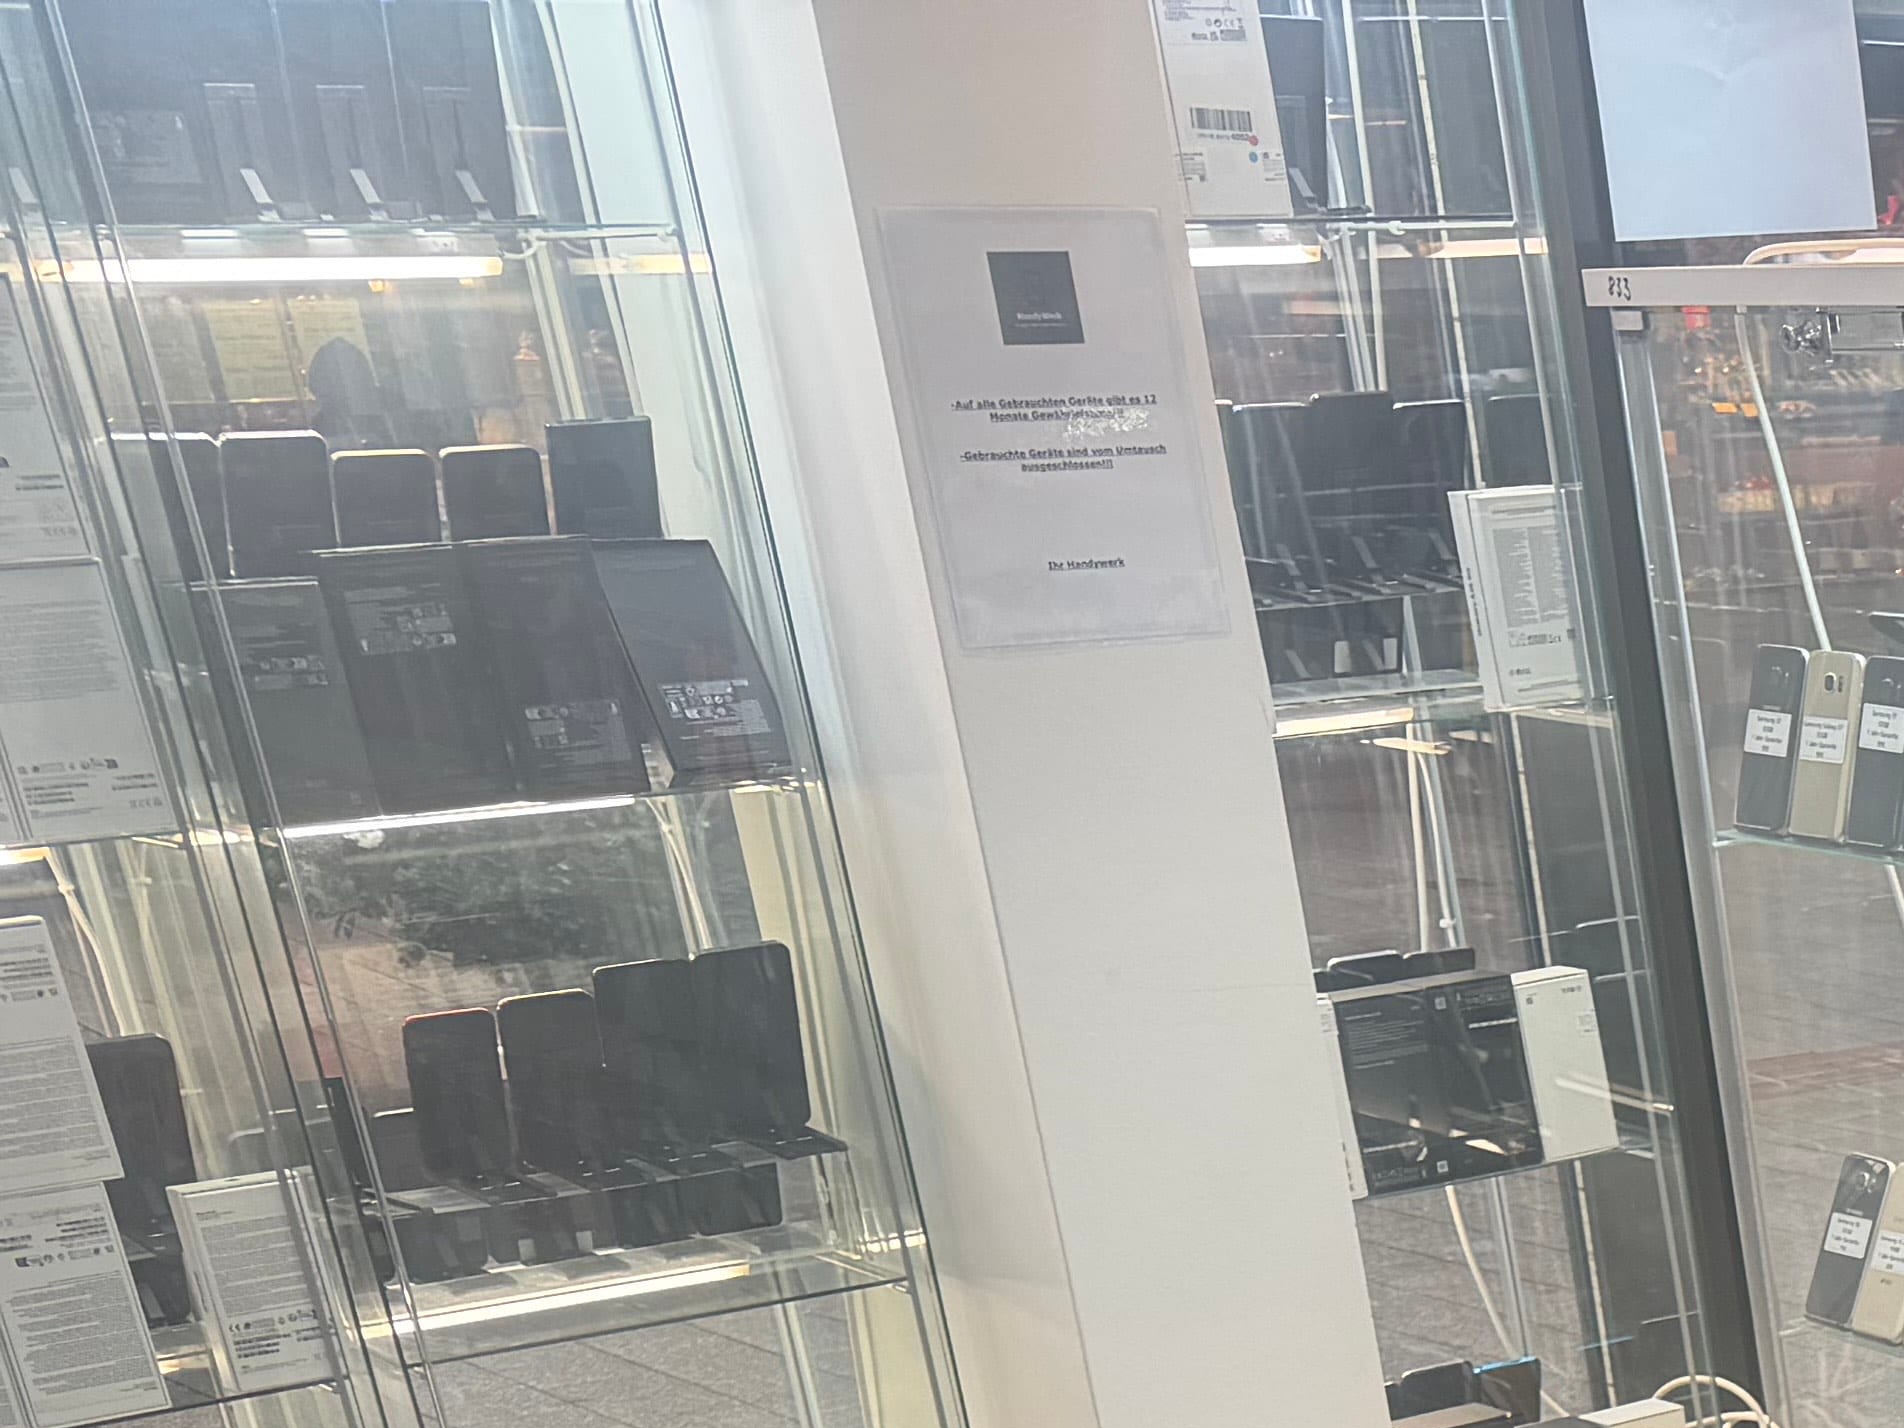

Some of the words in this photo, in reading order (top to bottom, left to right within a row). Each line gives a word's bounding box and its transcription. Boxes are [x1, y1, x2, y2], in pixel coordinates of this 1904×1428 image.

[999, 399, 1066, 408] Gebrauchten
[1145, 395, 1156, 404] 12
[1116, 445, 1166, 455] Umtausch
